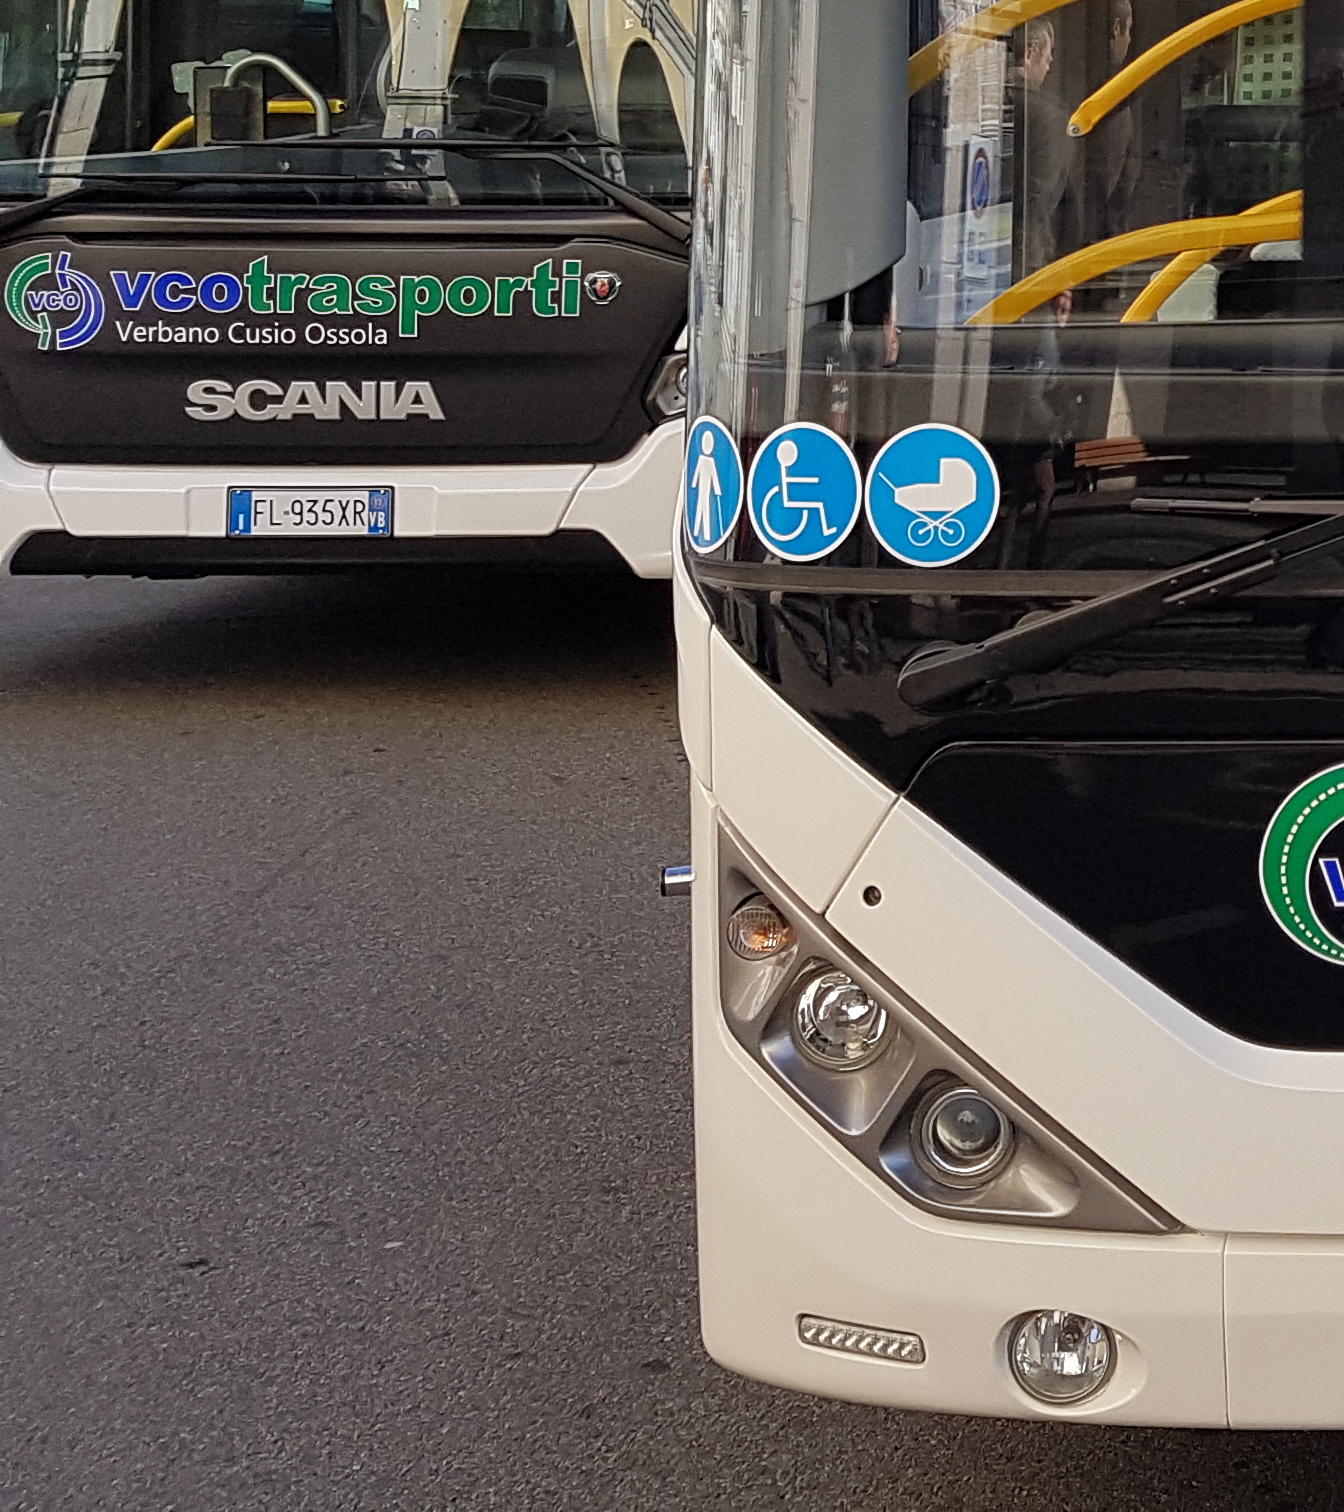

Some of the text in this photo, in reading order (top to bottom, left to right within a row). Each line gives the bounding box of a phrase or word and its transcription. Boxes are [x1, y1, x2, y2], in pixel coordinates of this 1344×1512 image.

[110, 255, 582, 338] vcotrasporti
[114, 319, 389, 346] Verbano Cusio Ossola
[184, 379, 446, 421] SCANIA
[369, 511, 386, 528] VB
